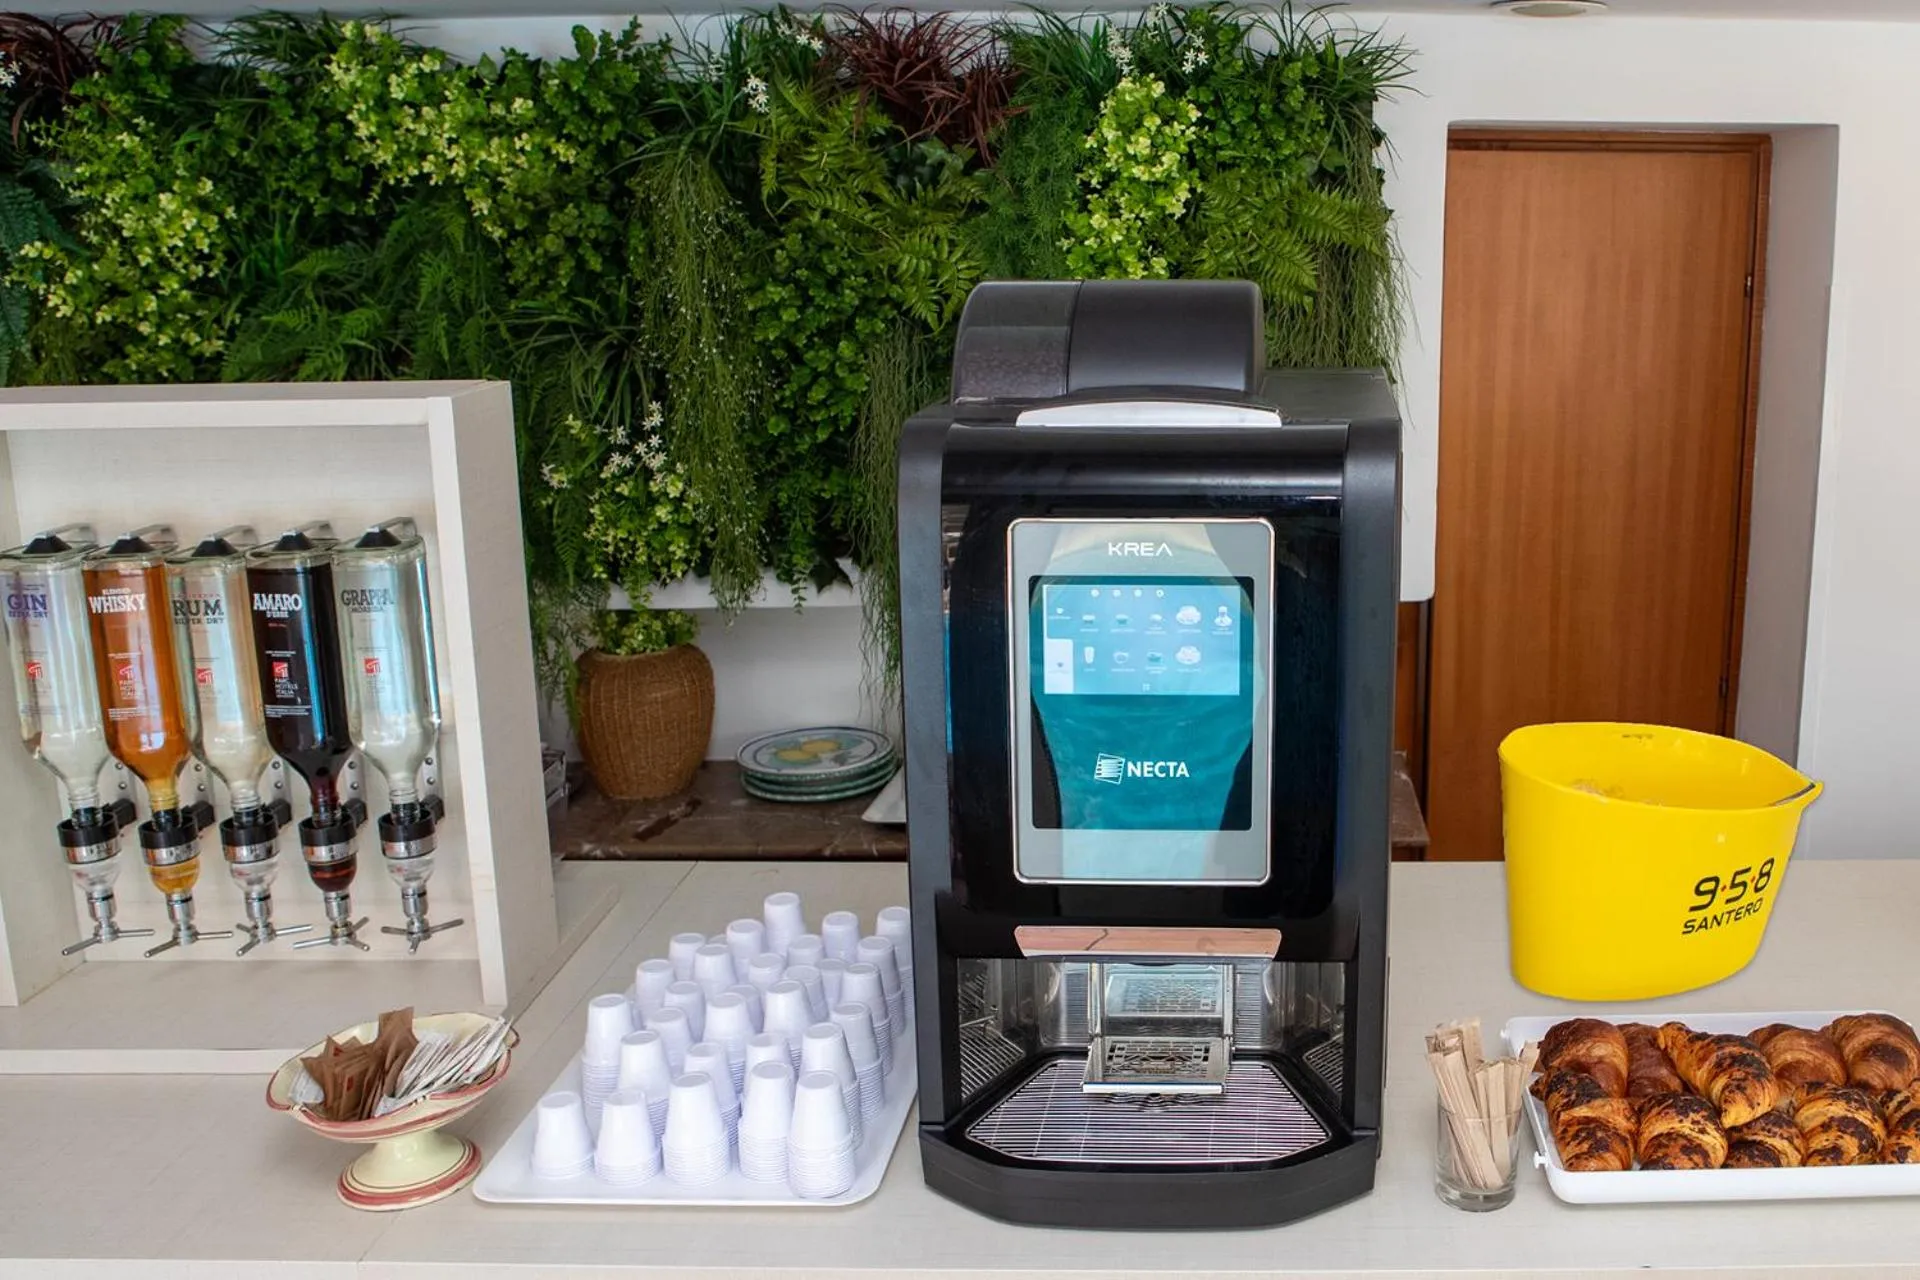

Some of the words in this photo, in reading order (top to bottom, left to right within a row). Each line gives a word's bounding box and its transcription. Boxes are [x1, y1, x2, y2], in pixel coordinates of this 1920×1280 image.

[1108, 542, 1173, 557] KREA
[7, 593, 47, 611] GIN
[88, 593, 146, 614] WHISKY
[172, 599, 224, 617] RUM
[253, 593, 303, 611] AMARO
[206, 617, 224, 625] DRY
[1127, 759, 1190, 778] NECTA
[1681, 897, 1764, 935] SANTERO
